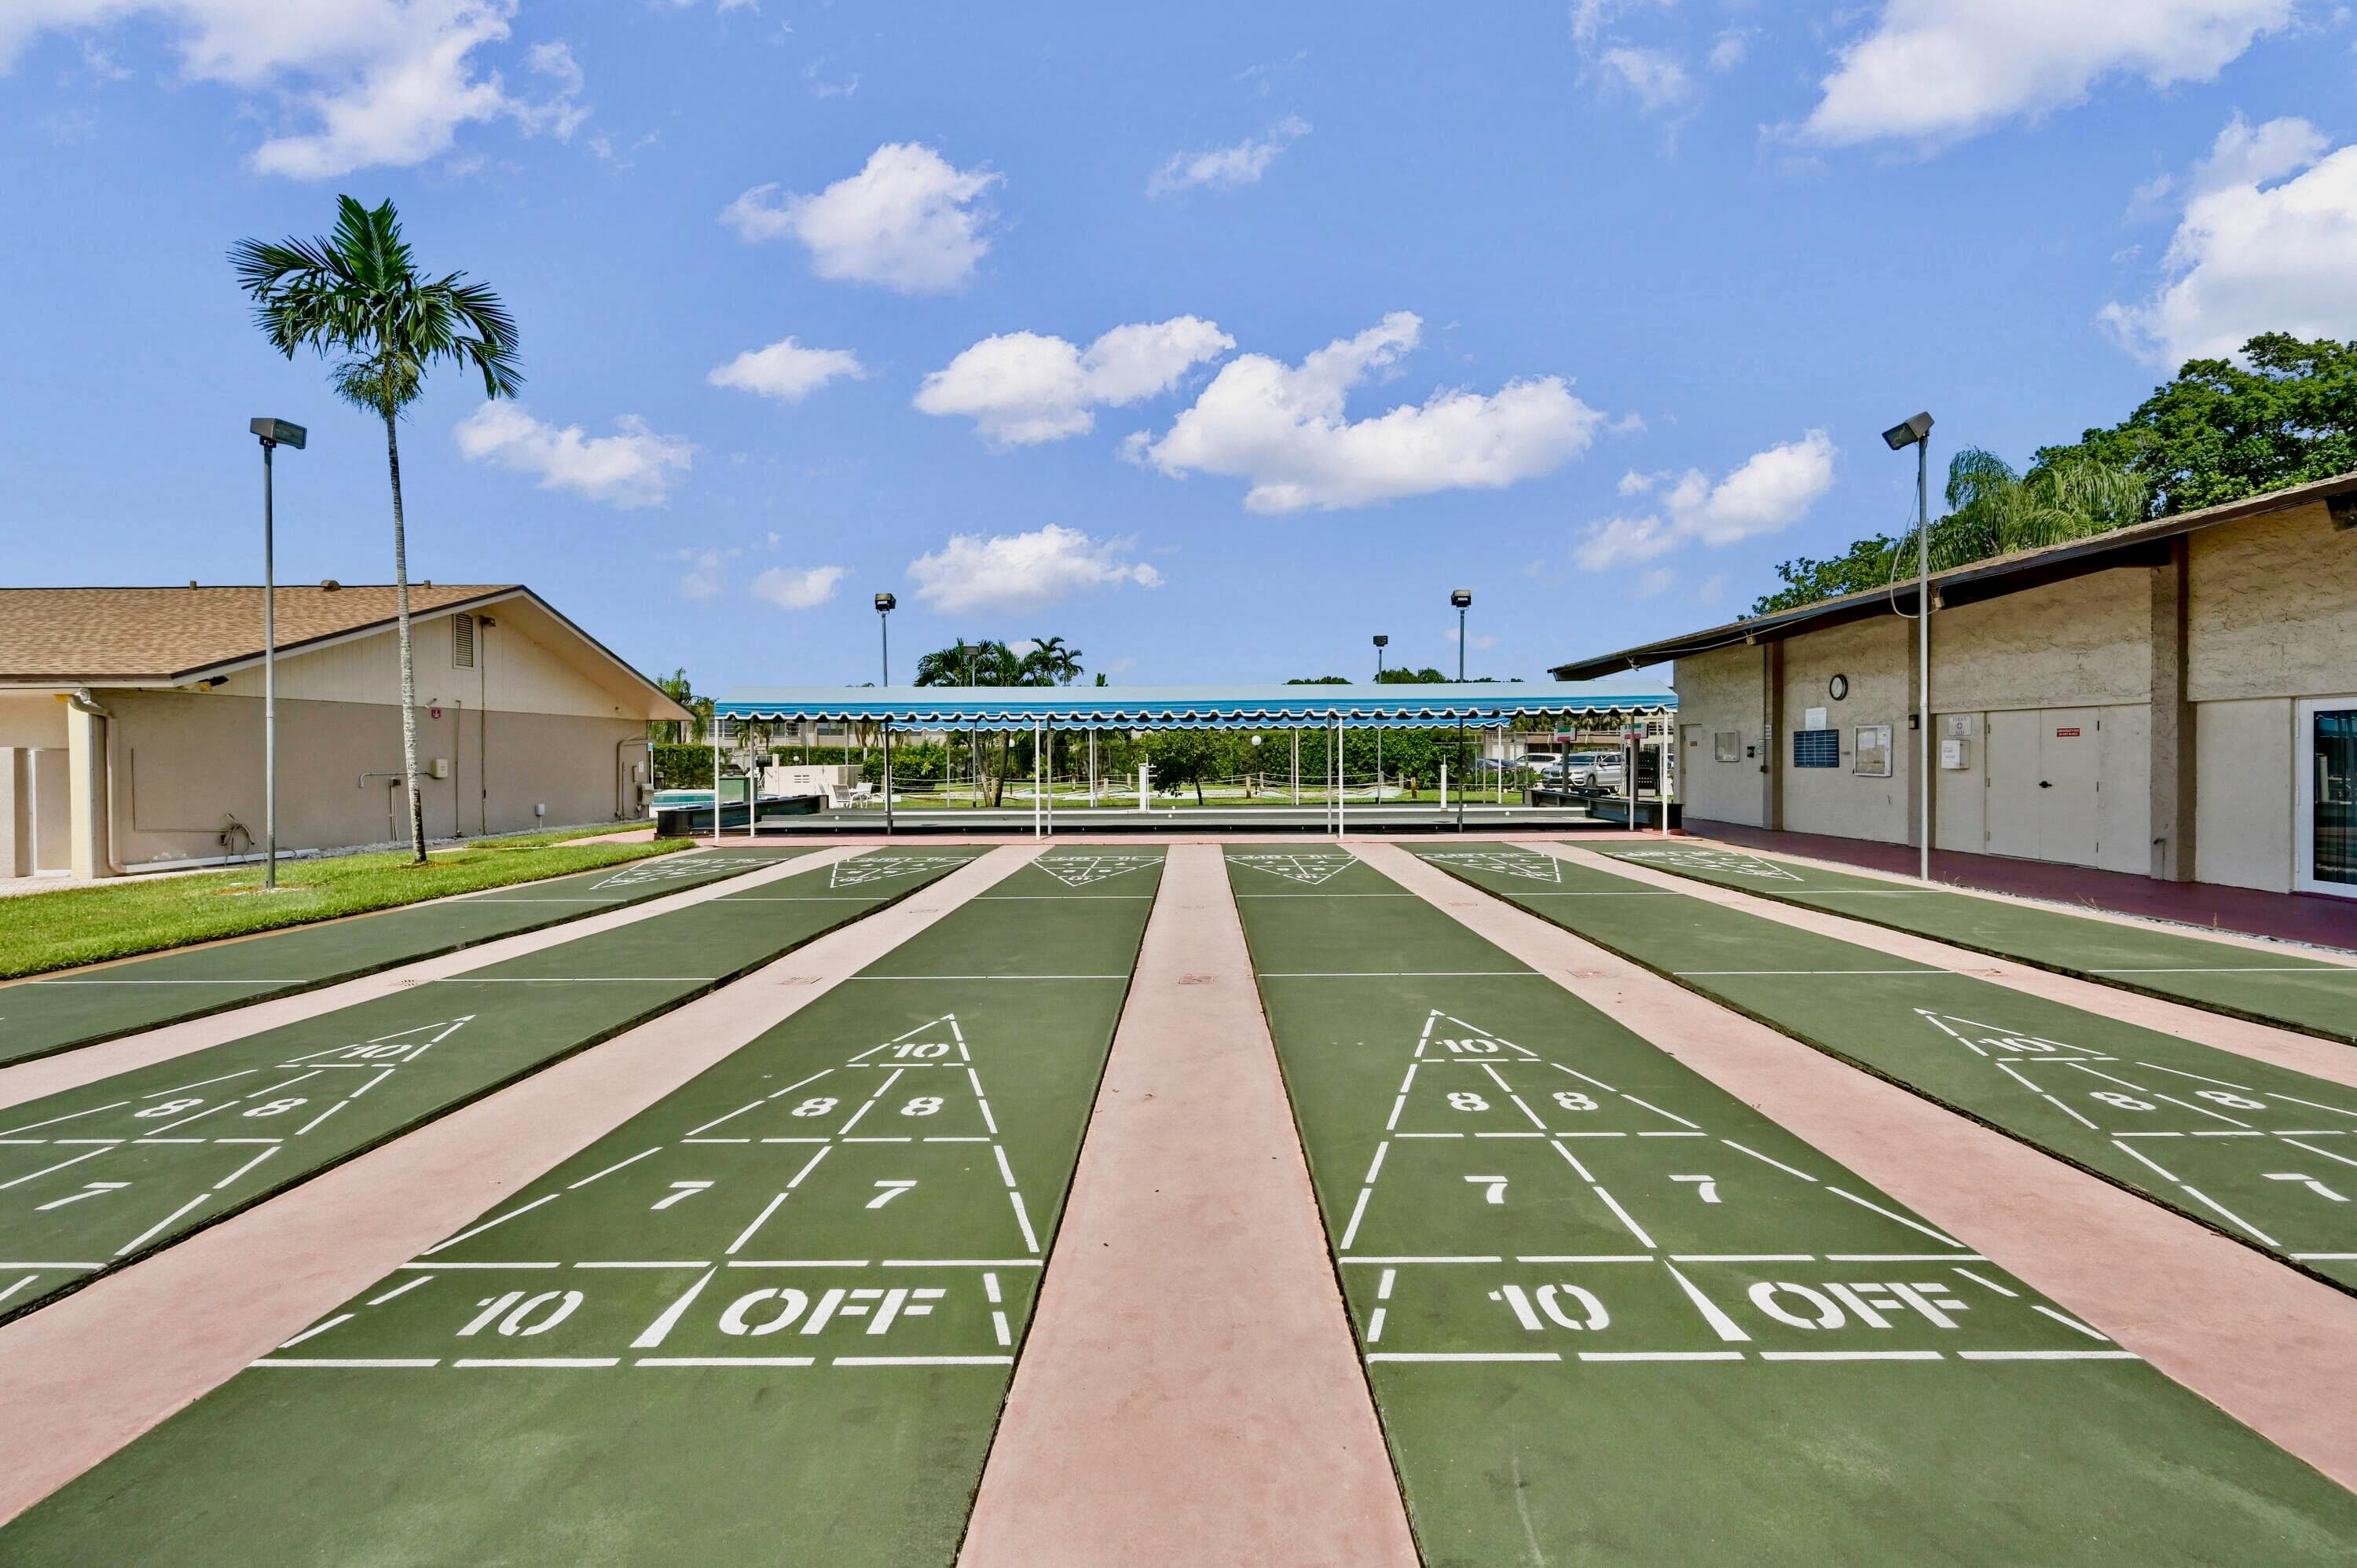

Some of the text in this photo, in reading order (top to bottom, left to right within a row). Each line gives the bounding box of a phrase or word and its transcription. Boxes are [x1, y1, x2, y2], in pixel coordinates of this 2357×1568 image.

[339, 1044, 413, 1059] 10
[892, 1043, 950, 1058] 10
[1437, 1039, 1499, 1053] 10
[1978, 1038, 2056, 1052] 10
[134, 1098, 204, 1118] 8
[242, 1097, 308, 1117] 8
[791, 1097, 839, 1117] 8
[900, 1097, 944, 1116] 8
[1446, 1092, 1490, 1112] 8
[1552, 1091, 1599, 1111] 8
[2089, 1091, 2157, 1111] 8
[2194, 1090, 2267, 1110] 8
[34, 1181, 133, 1211] 7
[650, 1181, 715, 1210] 7
[865, 1180, 918, 1209] 7
[1464, 1175, 1509, 1204] 7
[1668, 1174, 1722, 1203] 7
[2261, 1173, 2352, 1202] 7
[456, 1288, 947, 1336] 10 OFF
[1487, 1281, 1970, 1331] 10 OFF
